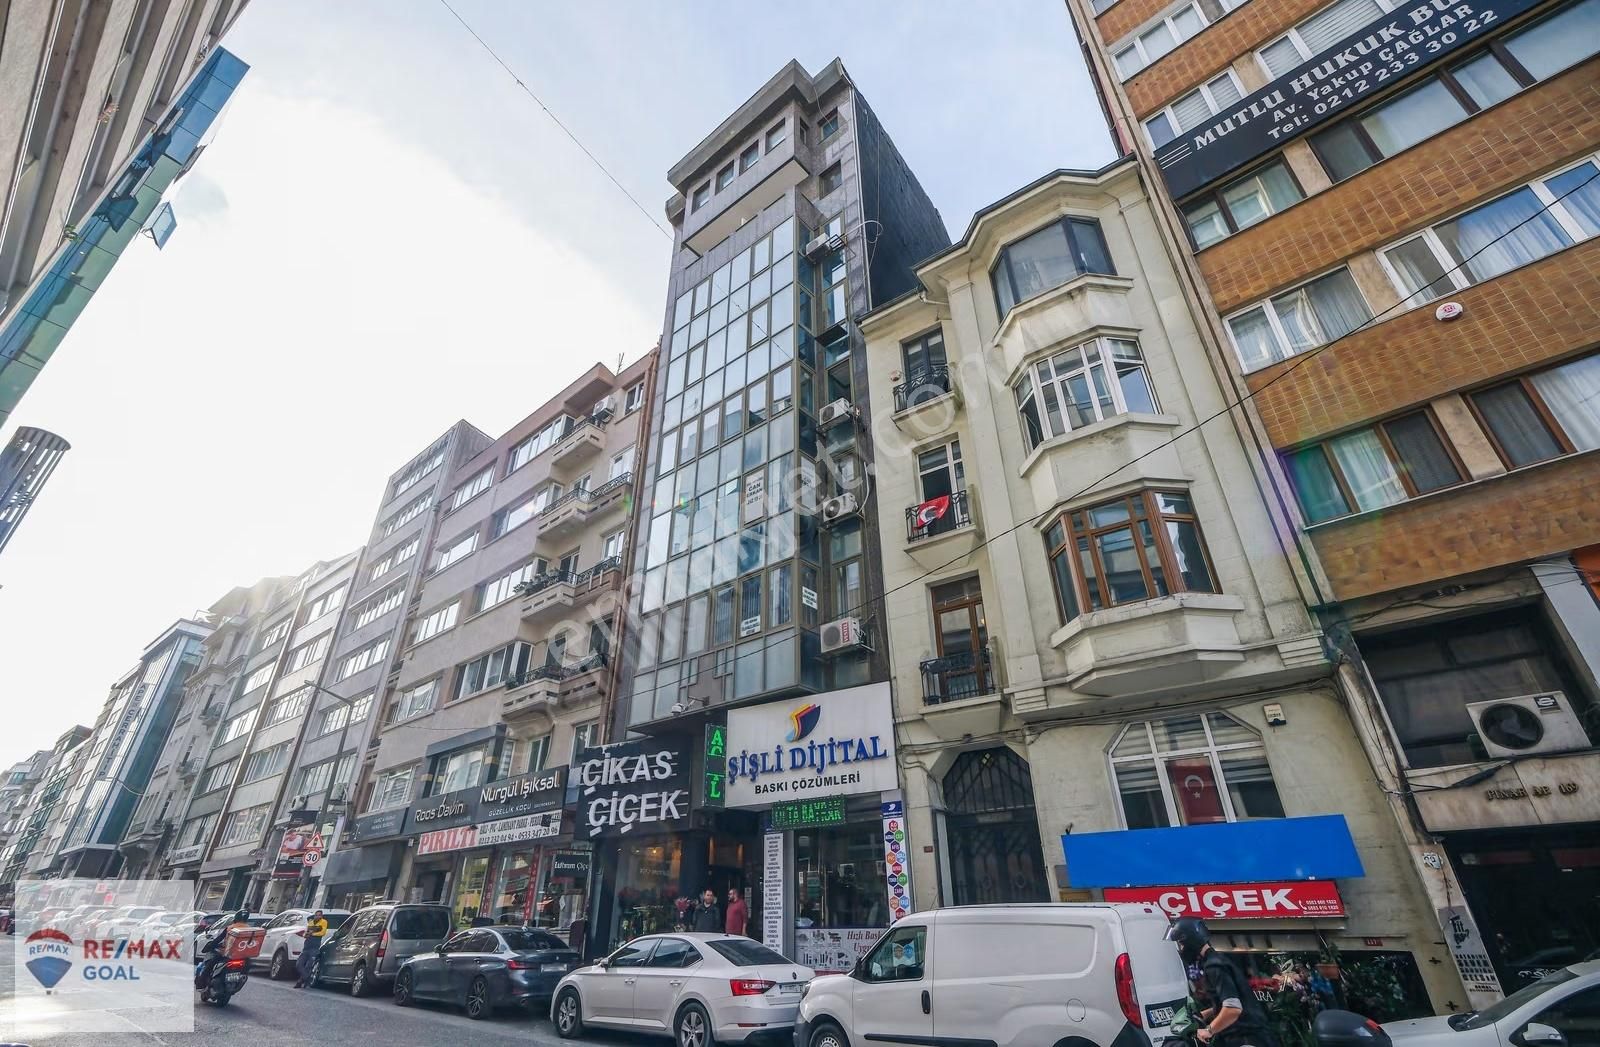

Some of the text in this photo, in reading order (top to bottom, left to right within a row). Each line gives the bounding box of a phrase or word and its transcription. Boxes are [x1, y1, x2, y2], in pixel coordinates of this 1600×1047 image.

[1268, 9, 1498, 139] Tel: 0212 233 30 22
[1273, 4, 1474, 122] Av. Yakup ÇAĞLAR
[1194, 90, 1287, 150] MUTLU
[1289, 22, 1406, 94] HUKUK
[583, 751, 673, 796] ÇİKAS
[728, 736, 887, 785] ŞİŞLİ DİJİTAL
[755, 770, 860, 794] BASKI ÇÖZÜMLERİ
[479, 781, 518, 804] Nurgül
[588, 790, 683, 837] ÇİÇEK
[306, 853, 318, 863] 30
[418, 827, 478, 853] PIRILTI
[1159, 887, 1302, 917] ÇİÇEK
